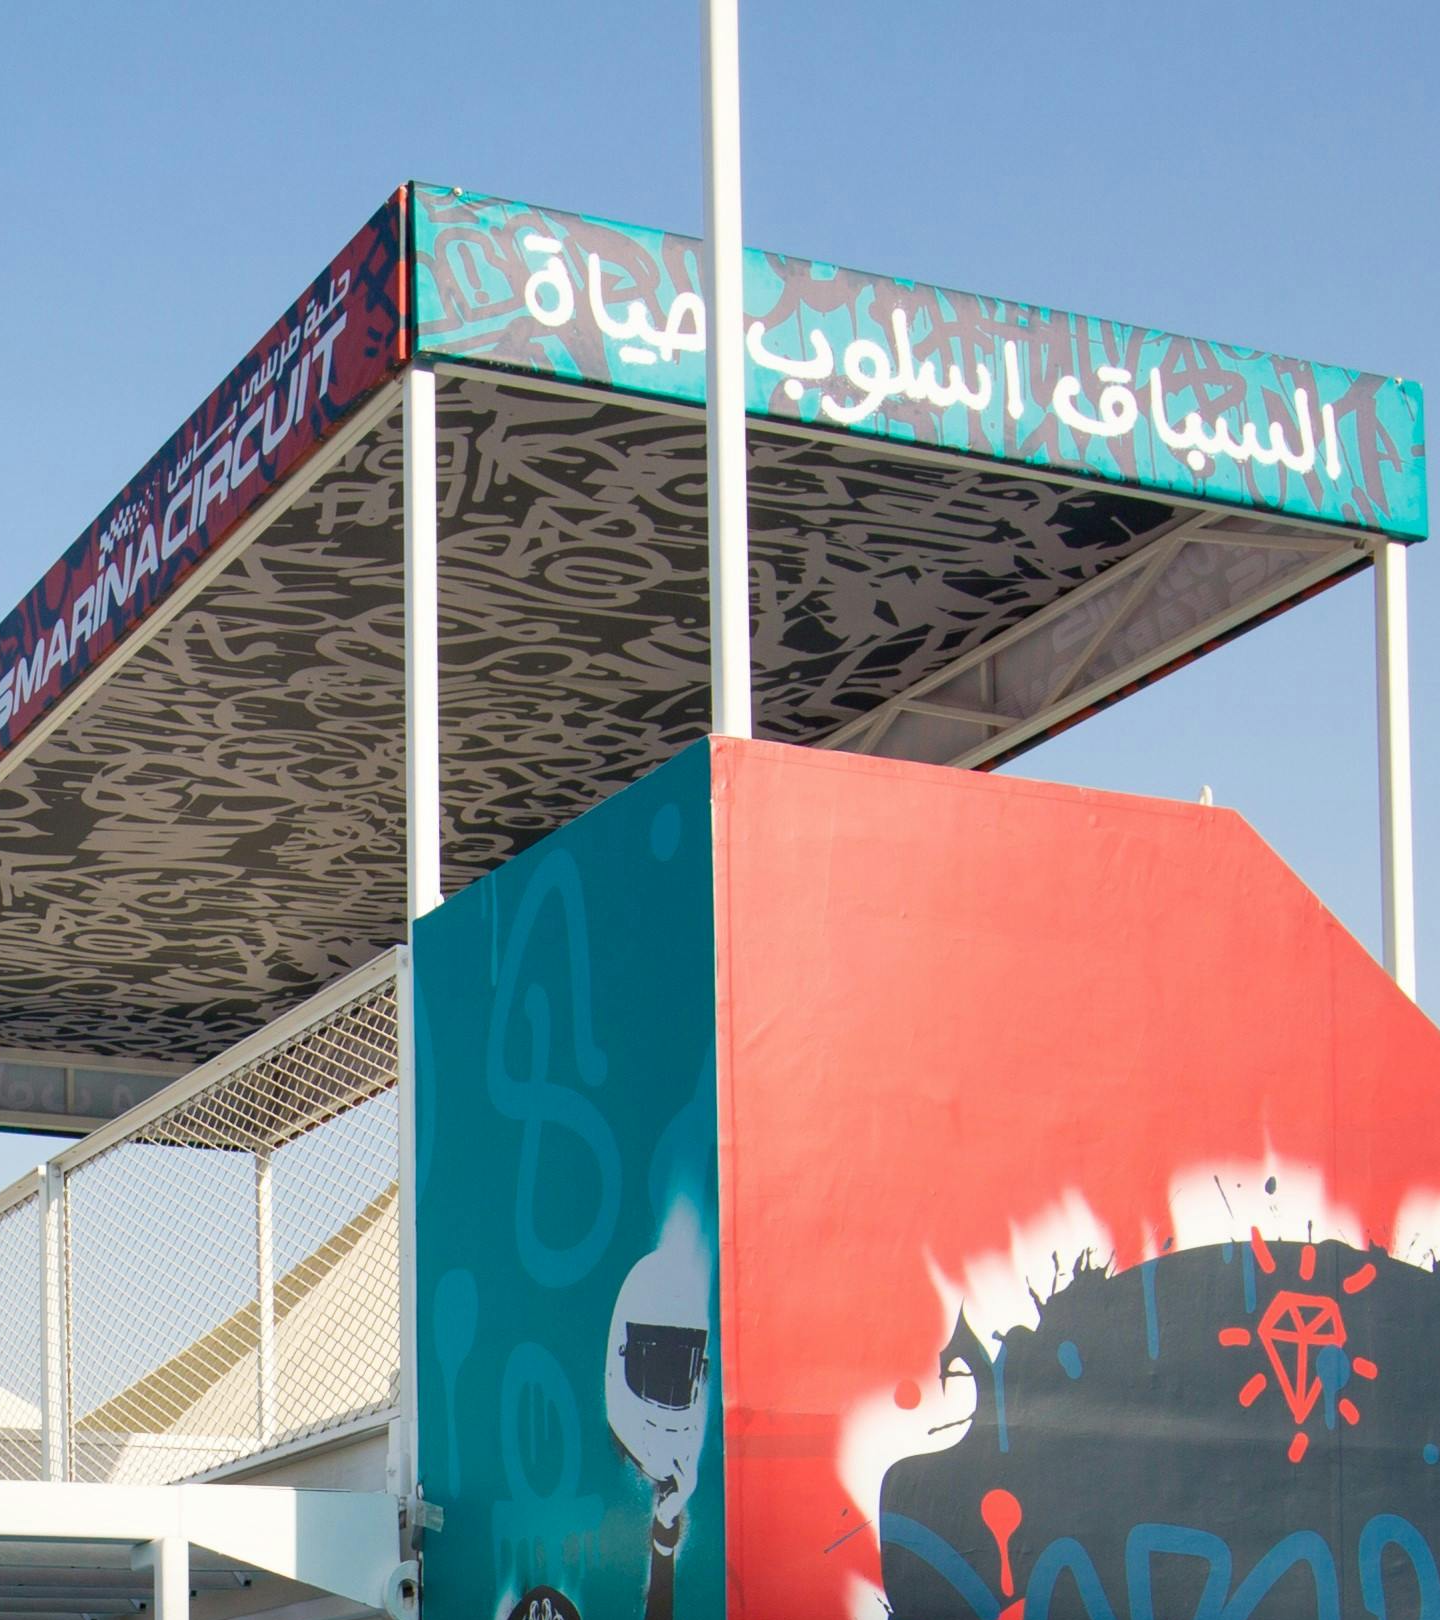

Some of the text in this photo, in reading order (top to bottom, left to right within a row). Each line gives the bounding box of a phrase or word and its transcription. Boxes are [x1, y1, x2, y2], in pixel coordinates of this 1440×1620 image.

[303, 268, 351, 340] حلبة
[745, 308, 1025, 424] اسلوب
[1052, 368, 1341, 481] السباق
